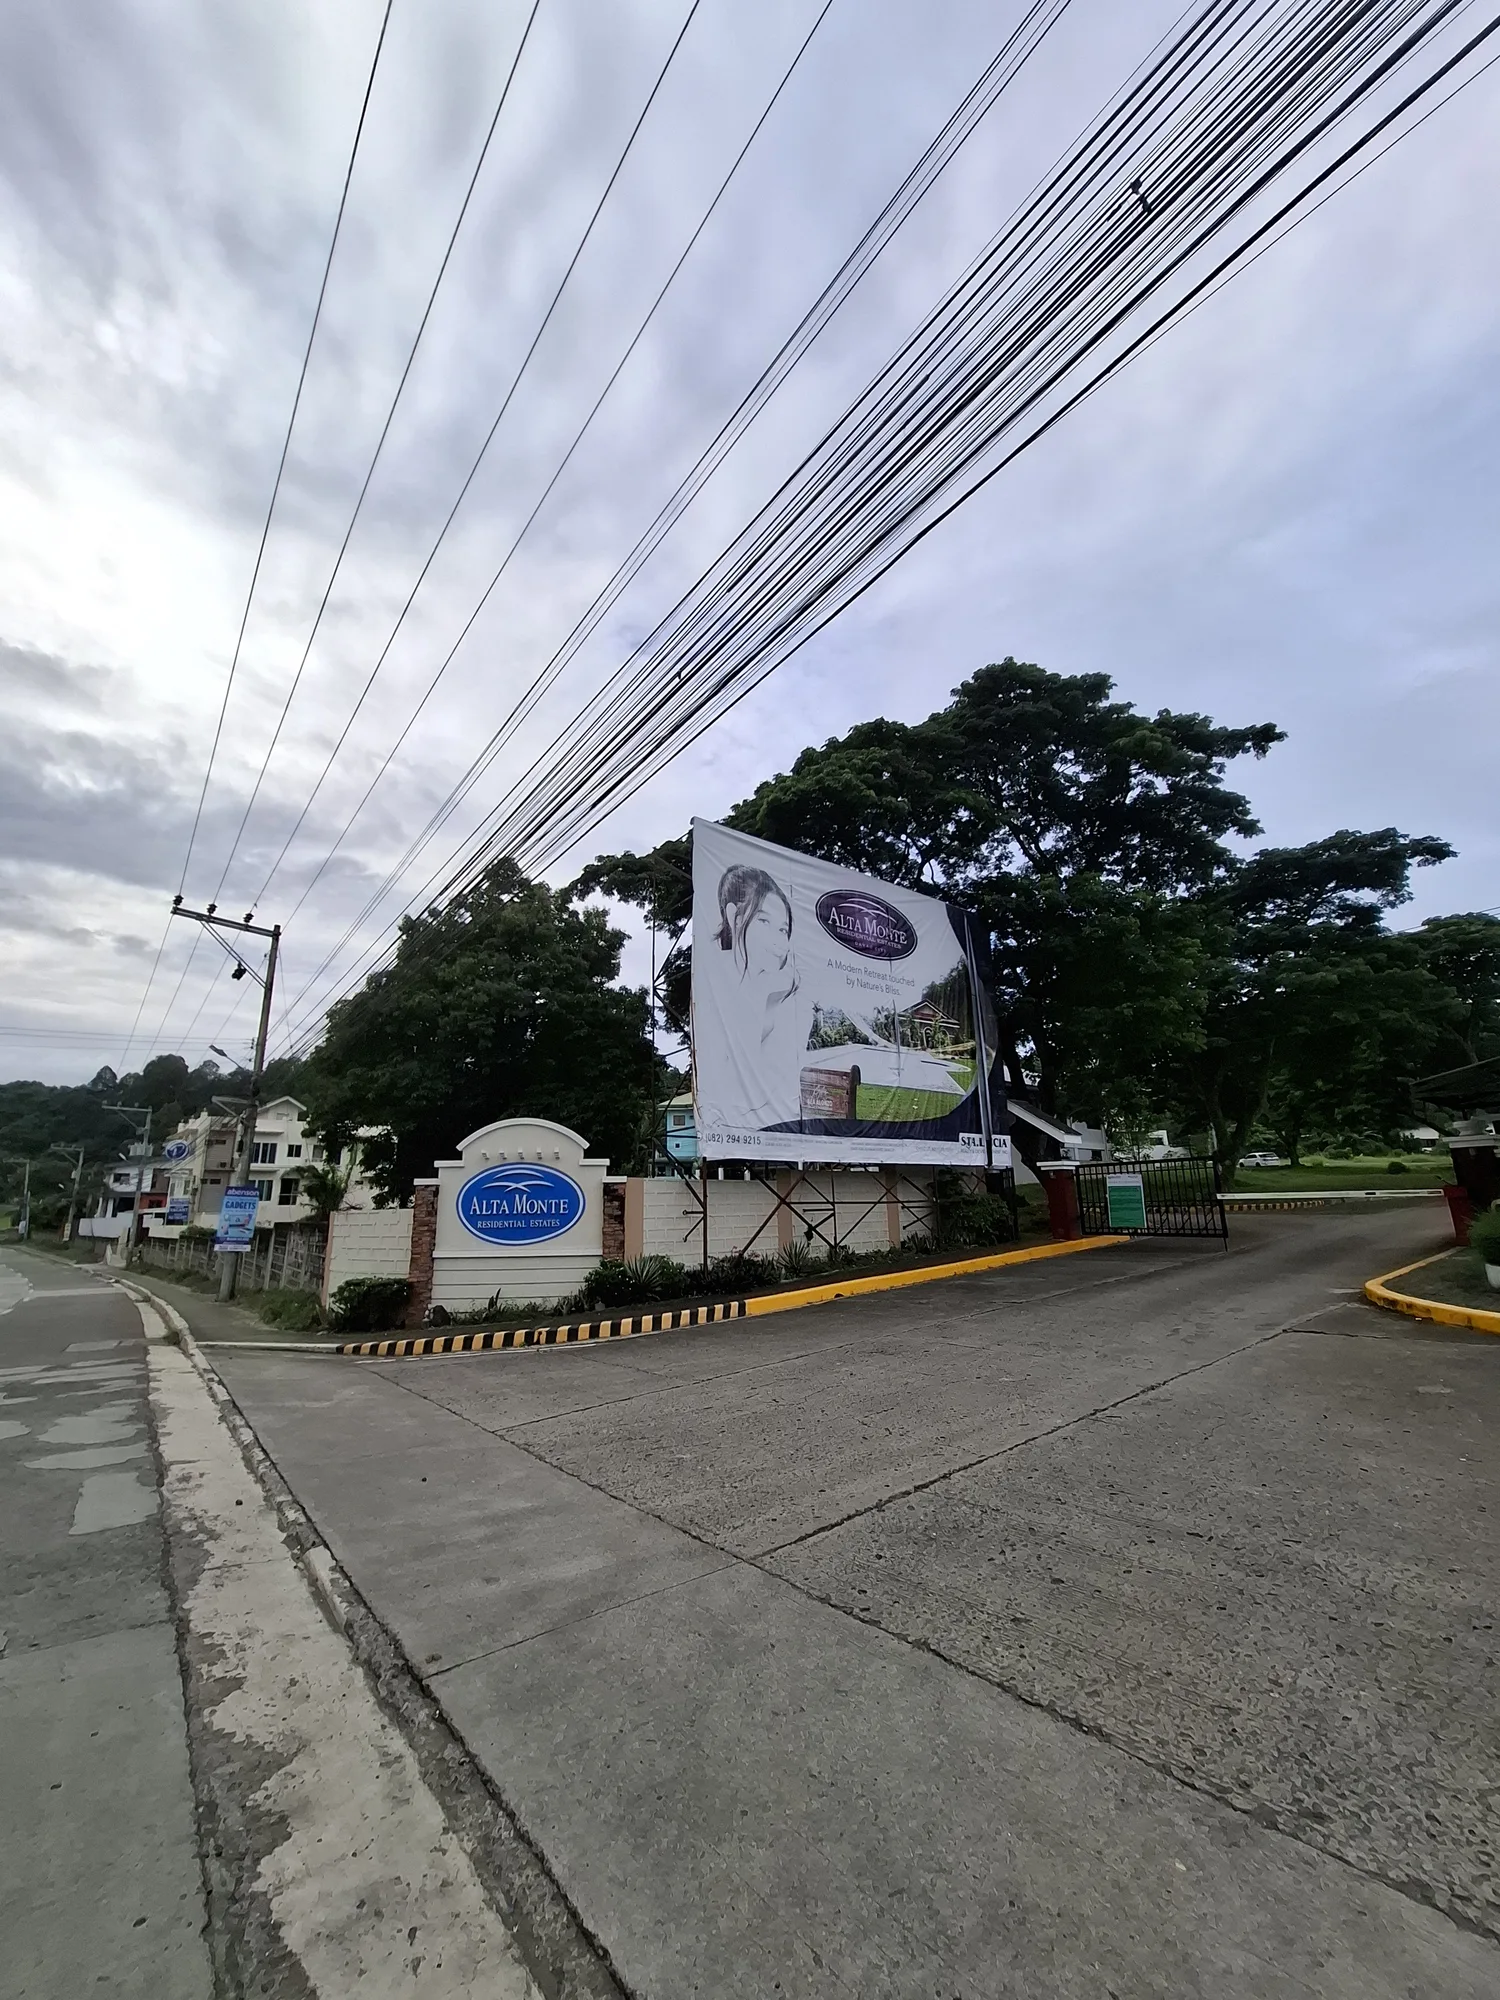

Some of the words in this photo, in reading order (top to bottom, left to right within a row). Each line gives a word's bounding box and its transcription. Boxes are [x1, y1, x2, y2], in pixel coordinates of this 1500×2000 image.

[828, 907, 862, 933] ALTA
[864, 917, 907, 945] MONTE
[836, 926, 876, 943] RESIDENTIAL
[877, 938, 902, 949] ESTATES
[827, 958, 834, 969] A
[835, 960, 863, 975] Modern
[864, 966, 889, 982] Retreat
[889, 973, 915, 987] touched
[846, 975, 856, 988] by
[857, 977, 884, 993] Nature's
[726, 1134, 740, 1144] 294
[743, 1135, 761, 1146] 9215
[961, 1136, 1008, 1148] STA.LCIA
[227, 1188, 259, 1196] abenson
[225, 1200, 256, 1210] GADGETS
[470, 1196, 509, 1215] ALTA
[513, 1193, 569, 1214] MONTE
[477, 1219, 527, 1229] RESIDENTIAL
[530, 1218, 560, 1228] ESTATES
